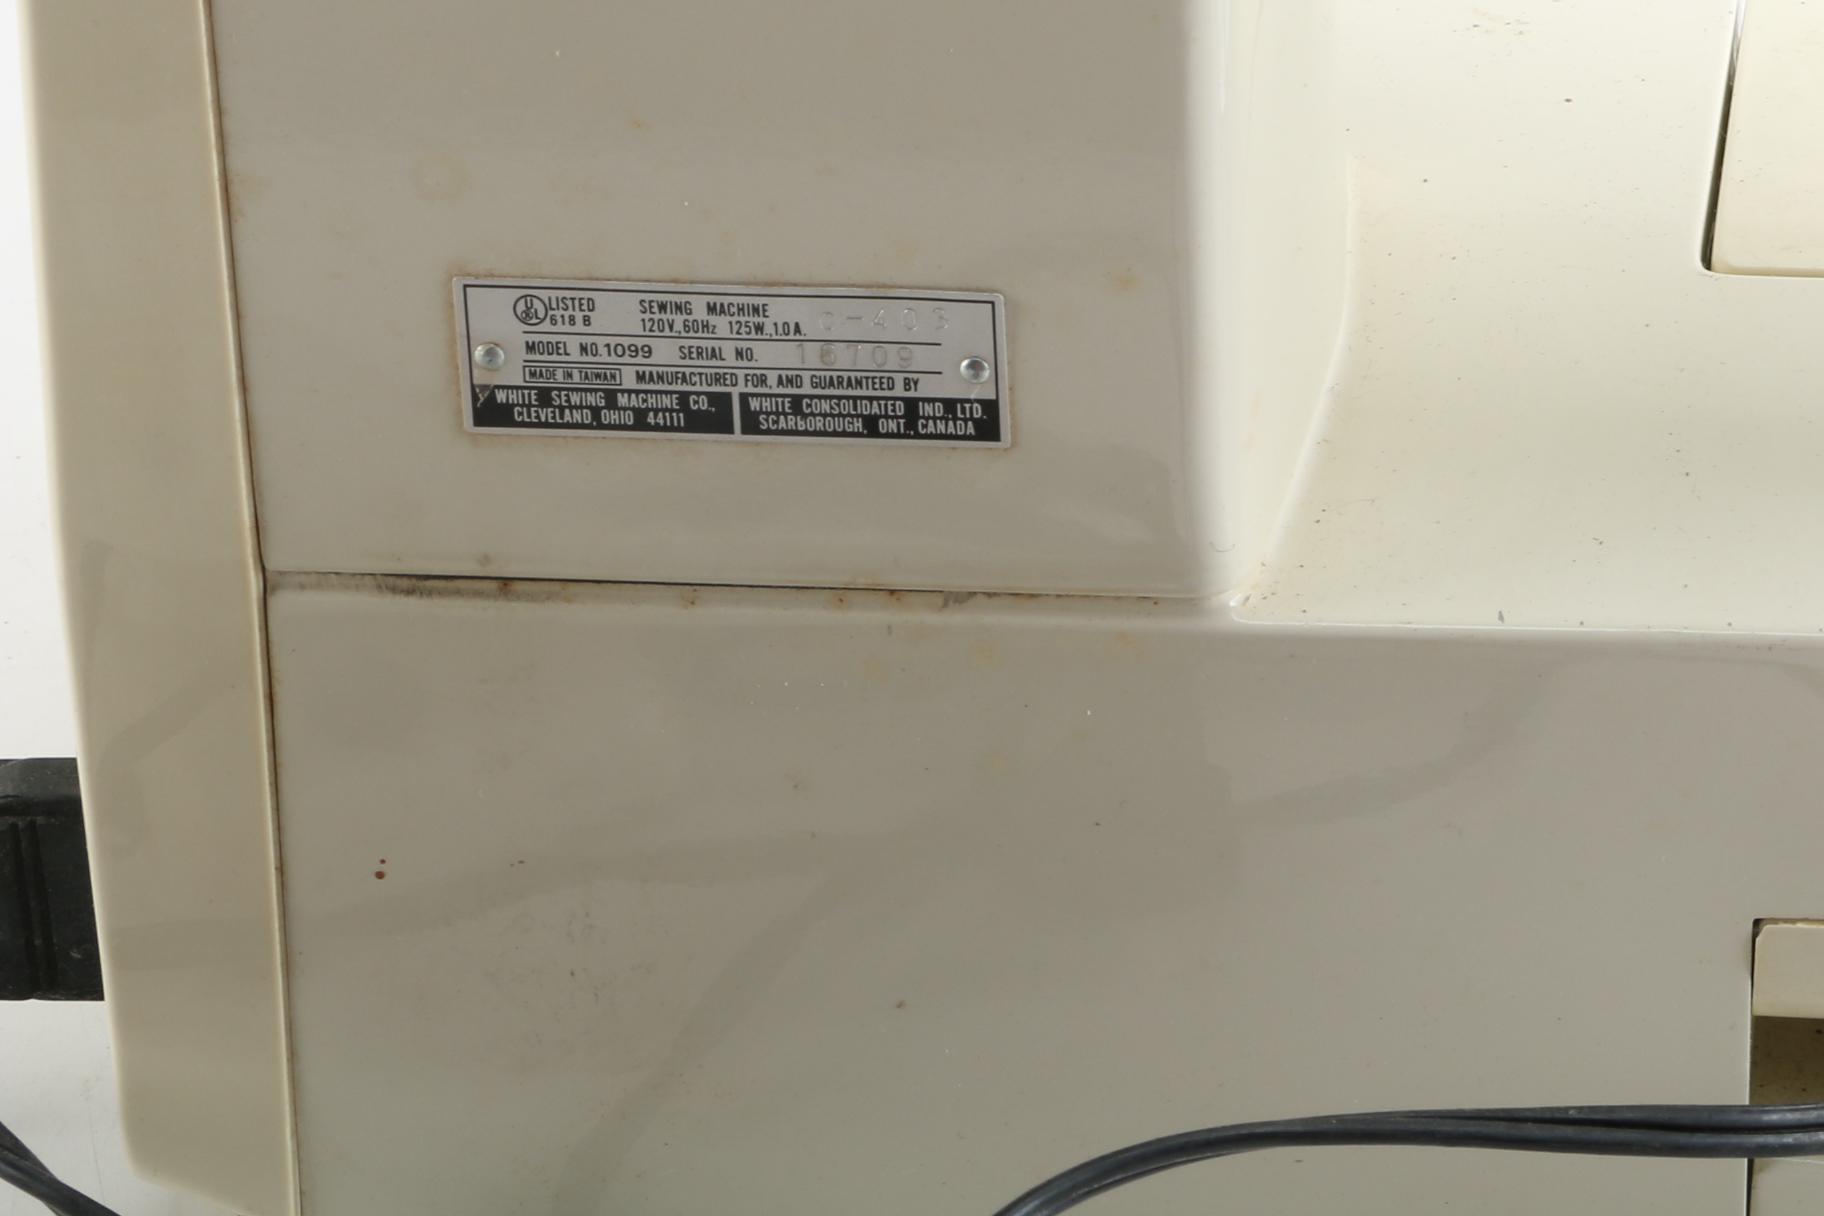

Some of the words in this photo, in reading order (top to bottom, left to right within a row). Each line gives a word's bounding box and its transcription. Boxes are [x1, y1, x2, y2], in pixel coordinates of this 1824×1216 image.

[548, 296, 595, 313] LISTED
[639, 299, 693, 316] SEWING
[706, 301, 770, 318] MACHINE
[550, 314, 577, 327] 618
[583, 315, 592, 327] B
[525, 341, 570, 357] MODEL
[679, 346, 726, 361] SERIAL
[735, 347, 758, 362] NO.
[528, 368, 558, 381] MADE
[562, 369, 574, 382] IN
[578, 370, 617, 383] TAIWAN
[635, 370, 738, 387] MANUFACTURED
[744, 373, 773, 390] FOR,
[776, 374, 804, 389] AND
[810, 375, 895, 392] GUARANTEED
[903, 377, 920, 392] BY
[495, 389, 538, 406] WHITE
[551, 390, 606, 407] SEWING
[617, 393, 680, 410] MACHINE
[748, 397, 792, 413] WHITE
[802, 399, 904, 416] CONSOLIDATED
[957, 403, 987, 419] LTD.
[514, 407, 597, 427] CLEVELAND,
[601, 410, 634, 426] OHIO
[647, 412, 685, 427] 44111
[918, 418, 976, 435] CANADA
